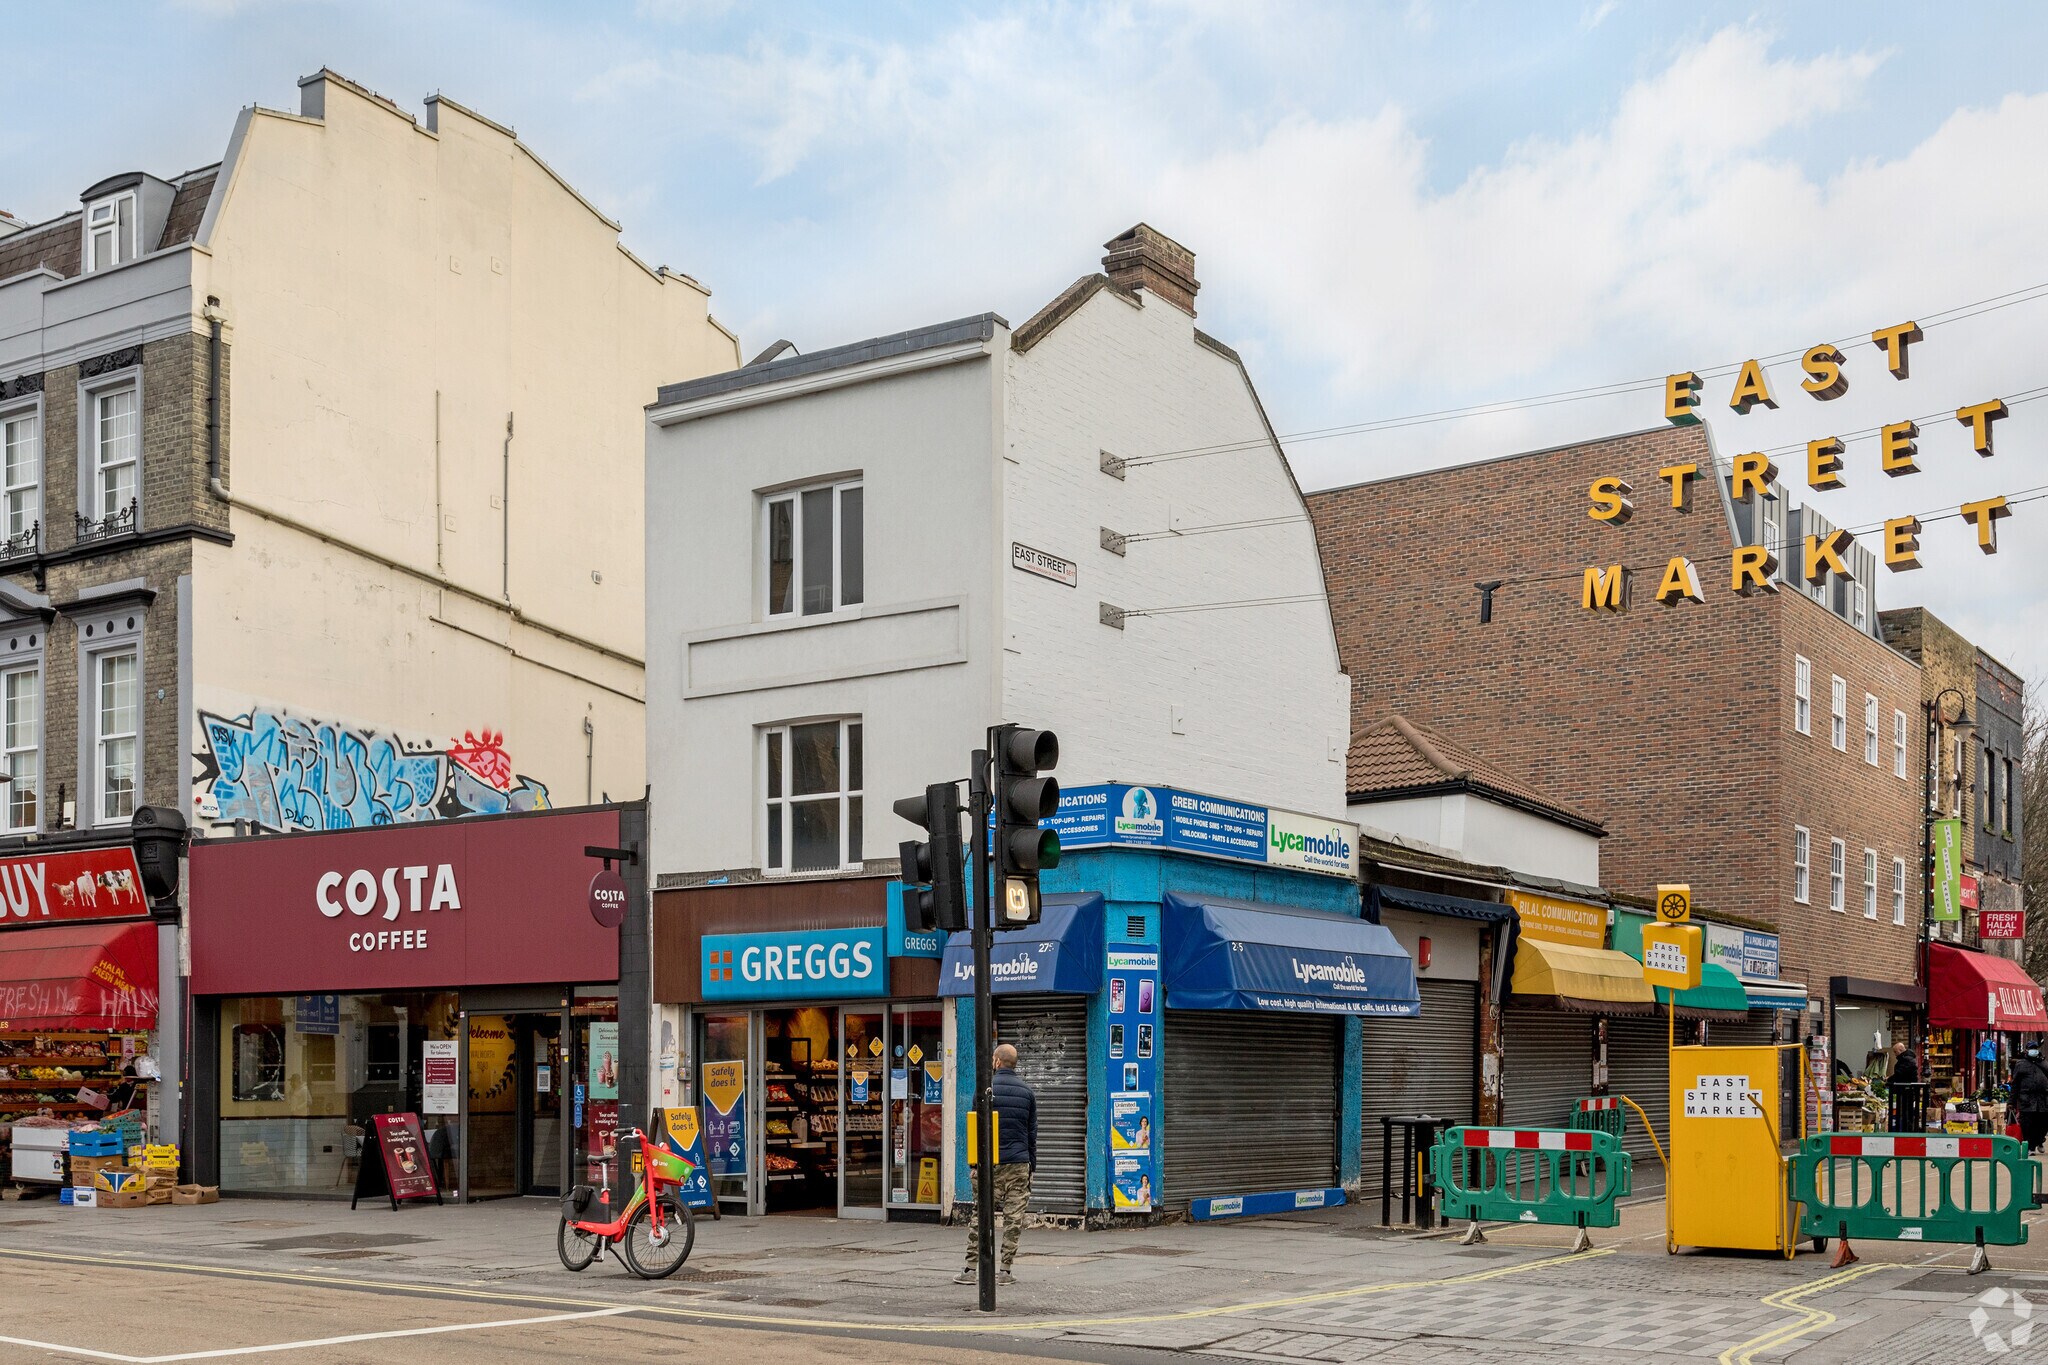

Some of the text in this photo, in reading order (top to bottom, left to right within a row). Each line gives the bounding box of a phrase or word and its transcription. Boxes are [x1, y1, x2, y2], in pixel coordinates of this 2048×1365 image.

[1665, 321, 1923, 425] EAST
[1588, 398, 2009, 526] STREET
[1014, 546, 1035, 563] EAST
[1038, 554, 1066, 574] STREET
[1582, 496, 2012, 612] MARKET
[1172, 795, 1265, 823] GREEN COMMUNICATIONS
[1059, 825, 1098, 834] ACCESSORIES
[1118, 820, 1161, 831] Lycamobile
[1176, 816, 1192, 825] MOBILE
[1193, 818, 1208, 828] PHONE
[1224, 824, 1242, 834] TOP-UPS
[1246, 828, 1263, 837] REPAIRS
[1182, 829, 1207, 840] UNLOCKING
[1212, 834, 1225, 843] PARTS
[1230, 837, 1258, 848] ACCESSORIES
[1271, 824, 1350, 859] Lycamobile
[1304, 855, 1313, 863] Call
[1322, 859, 1333, 867] world
[0, 862, 50, 918] UY
[316, 864, 462, 920] COSTA
[594, 890, 625, 902] COSTA
[1520, 901, 1598, 926] BILAL COMMUNICATION
[349, 930, 427, 952] COFFEE
[905, 937, 937, 951] GREGGS
[1654, 944, 1678, 952] EAST
[1648, 952, 1685, 962] STREET
[1710, 939, 1742, 960] Lycamobile
[100, 960, 125, 979] HALAL
[741, 941, 873, 982] GREGGS
[954, 957, 1038, 980] Lycmobile
[1108, 956, 1157, 968] Lycamobile
[1647, 961, 1685, 972] MARKET
[1292, 958, 1365, 984] Lycamobile
[92, 966, 136, 993] FRESH MEAT
[1257, 997, 1269, 1006] Low
[1270, 999, 1284, 1008] cost,
[1285, 999, 1296, 1008] high
[1297, 1001, 1314, 1010] quality
[1362, 1003, 1375, 1012] calls,
[711, 1066, 735, 1077] Safely
[711, 1077, 736, 1087] does it
[1701, 1078, 1746, 1086] EAST
[1688, 1092, 1759, 1100] STREET
[670, 1113, 691, 1122] Safely
[1687, 1106, 1759, 1115] MARKET
[688, 1121, 694, 1130] it
[634, 1153, 643, 1171] H
[1212, 1200, 1242, 1213] Lycamobile
[1296, 1194, 1323, 1206] Lycamobile
